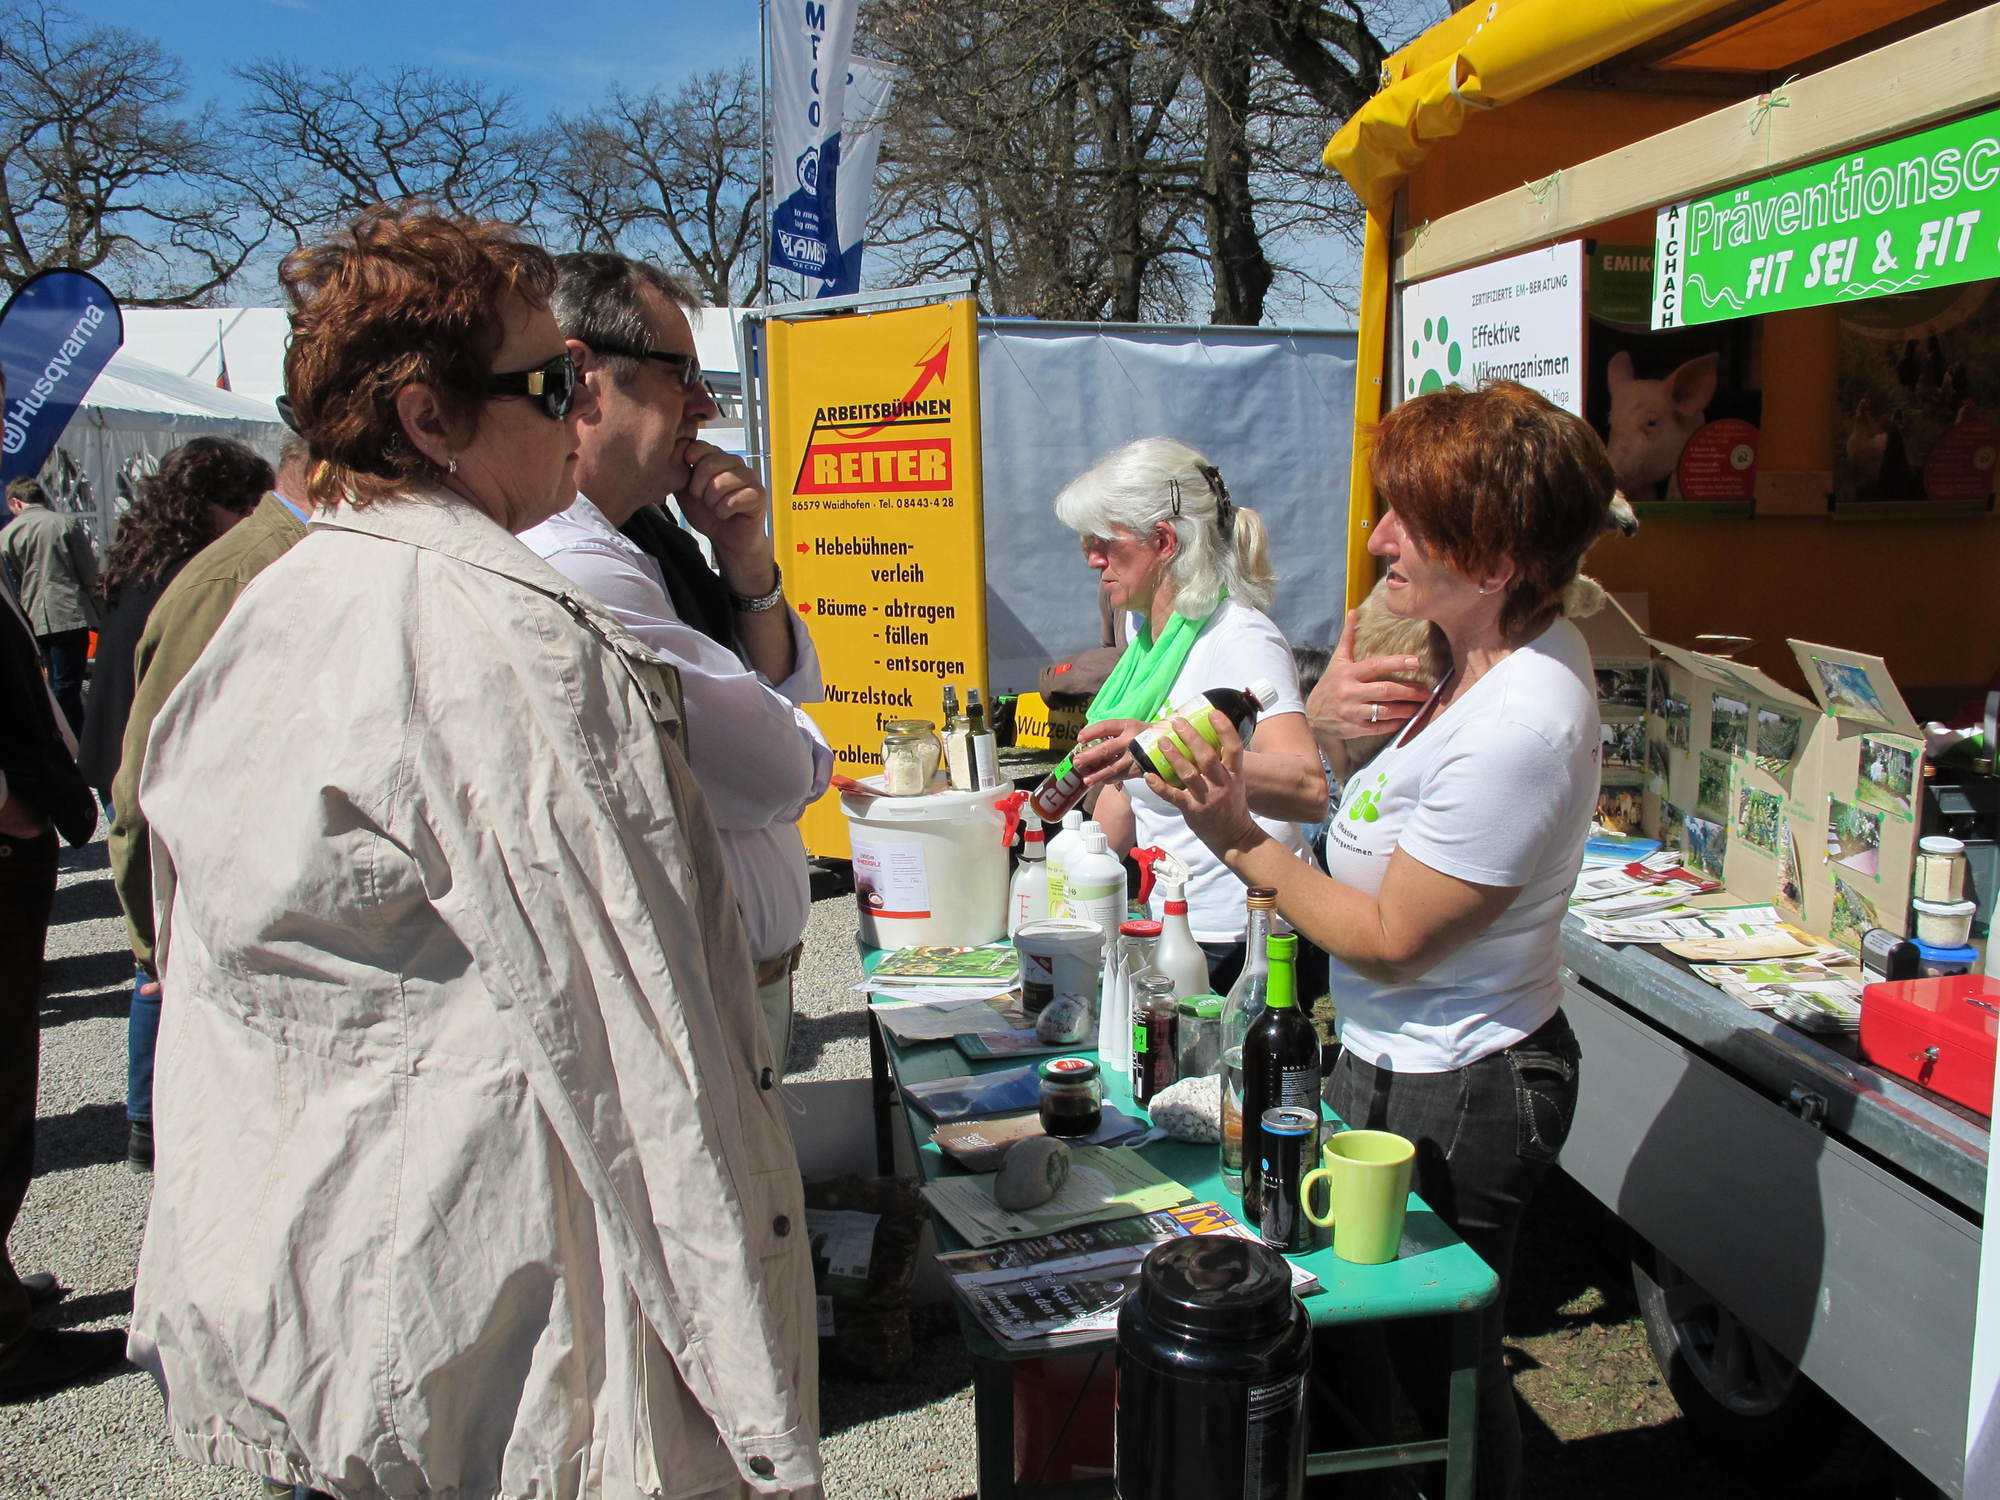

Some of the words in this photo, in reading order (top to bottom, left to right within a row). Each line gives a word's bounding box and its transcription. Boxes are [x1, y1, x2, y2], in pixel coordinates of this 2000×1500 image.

[1603, 255, 1653, 272] EMIK
[1661, 205, 1680, 328] AICHACH
[1745, 250, 1794, 299] FIT
[1804, 237, 1858, 289] SEI
[1872, 230, 1899, 275] &
[1914, 210, 1981, 270] FIT
[1471, 287, 1513, 307] ZERTIFIZIERTE
[1471, 321, 1521, 350] Effektive
[8, 303, 105, 428] Husqvarna
[1472, 354, 1569, 384] Mikroorganismen
[816, 399, 951, 422] ARBEITSBÜHNEN
[813, 448, 946, 485] REITER
[792, 501, 820, 510] 86579
[822, 499, 870, 510] Waidhofen
[879, 499, 894, 509] Tel.
[815, 537, 914, 555] Hebebühnen-
[871, 564, 924, 583] verleih
[817, 598, 867, 617] Bäume
[884, 598, 955, 624] abtragen
[885, 625, 929, 645] fällen
[886, 655, 965, 679] entsorgen
